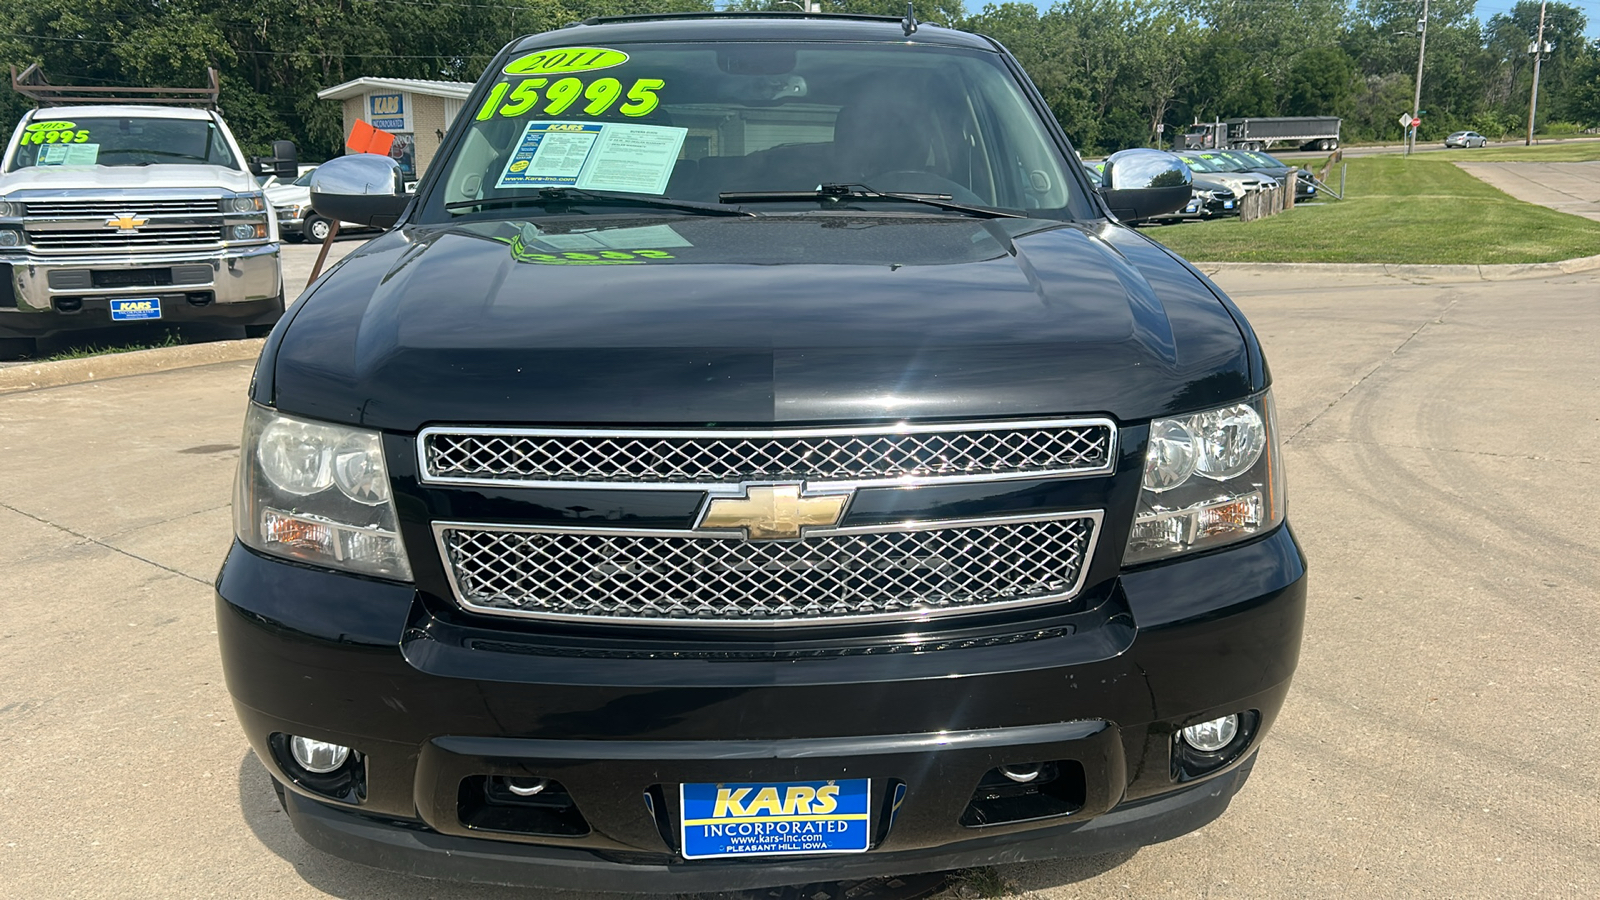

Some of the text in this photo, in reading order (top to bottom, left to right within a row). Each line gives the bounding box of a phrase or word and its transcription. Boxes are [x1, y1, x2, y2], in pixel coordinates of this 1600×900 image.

[520, 51, 608, 71] 2011
[374, 96, 399, 114] KARS
[476, 78, 665, 121] 15995
[20, 130, 90, 145] 14995
[120, 302, 152, 310] KARS
[713, 786, 839, 817] KARS
[704, 821, 848, 837] INCORPORATED
[726, 844, 777, 853] PLEASANT
[802, 842, 828, 850] IOWA
